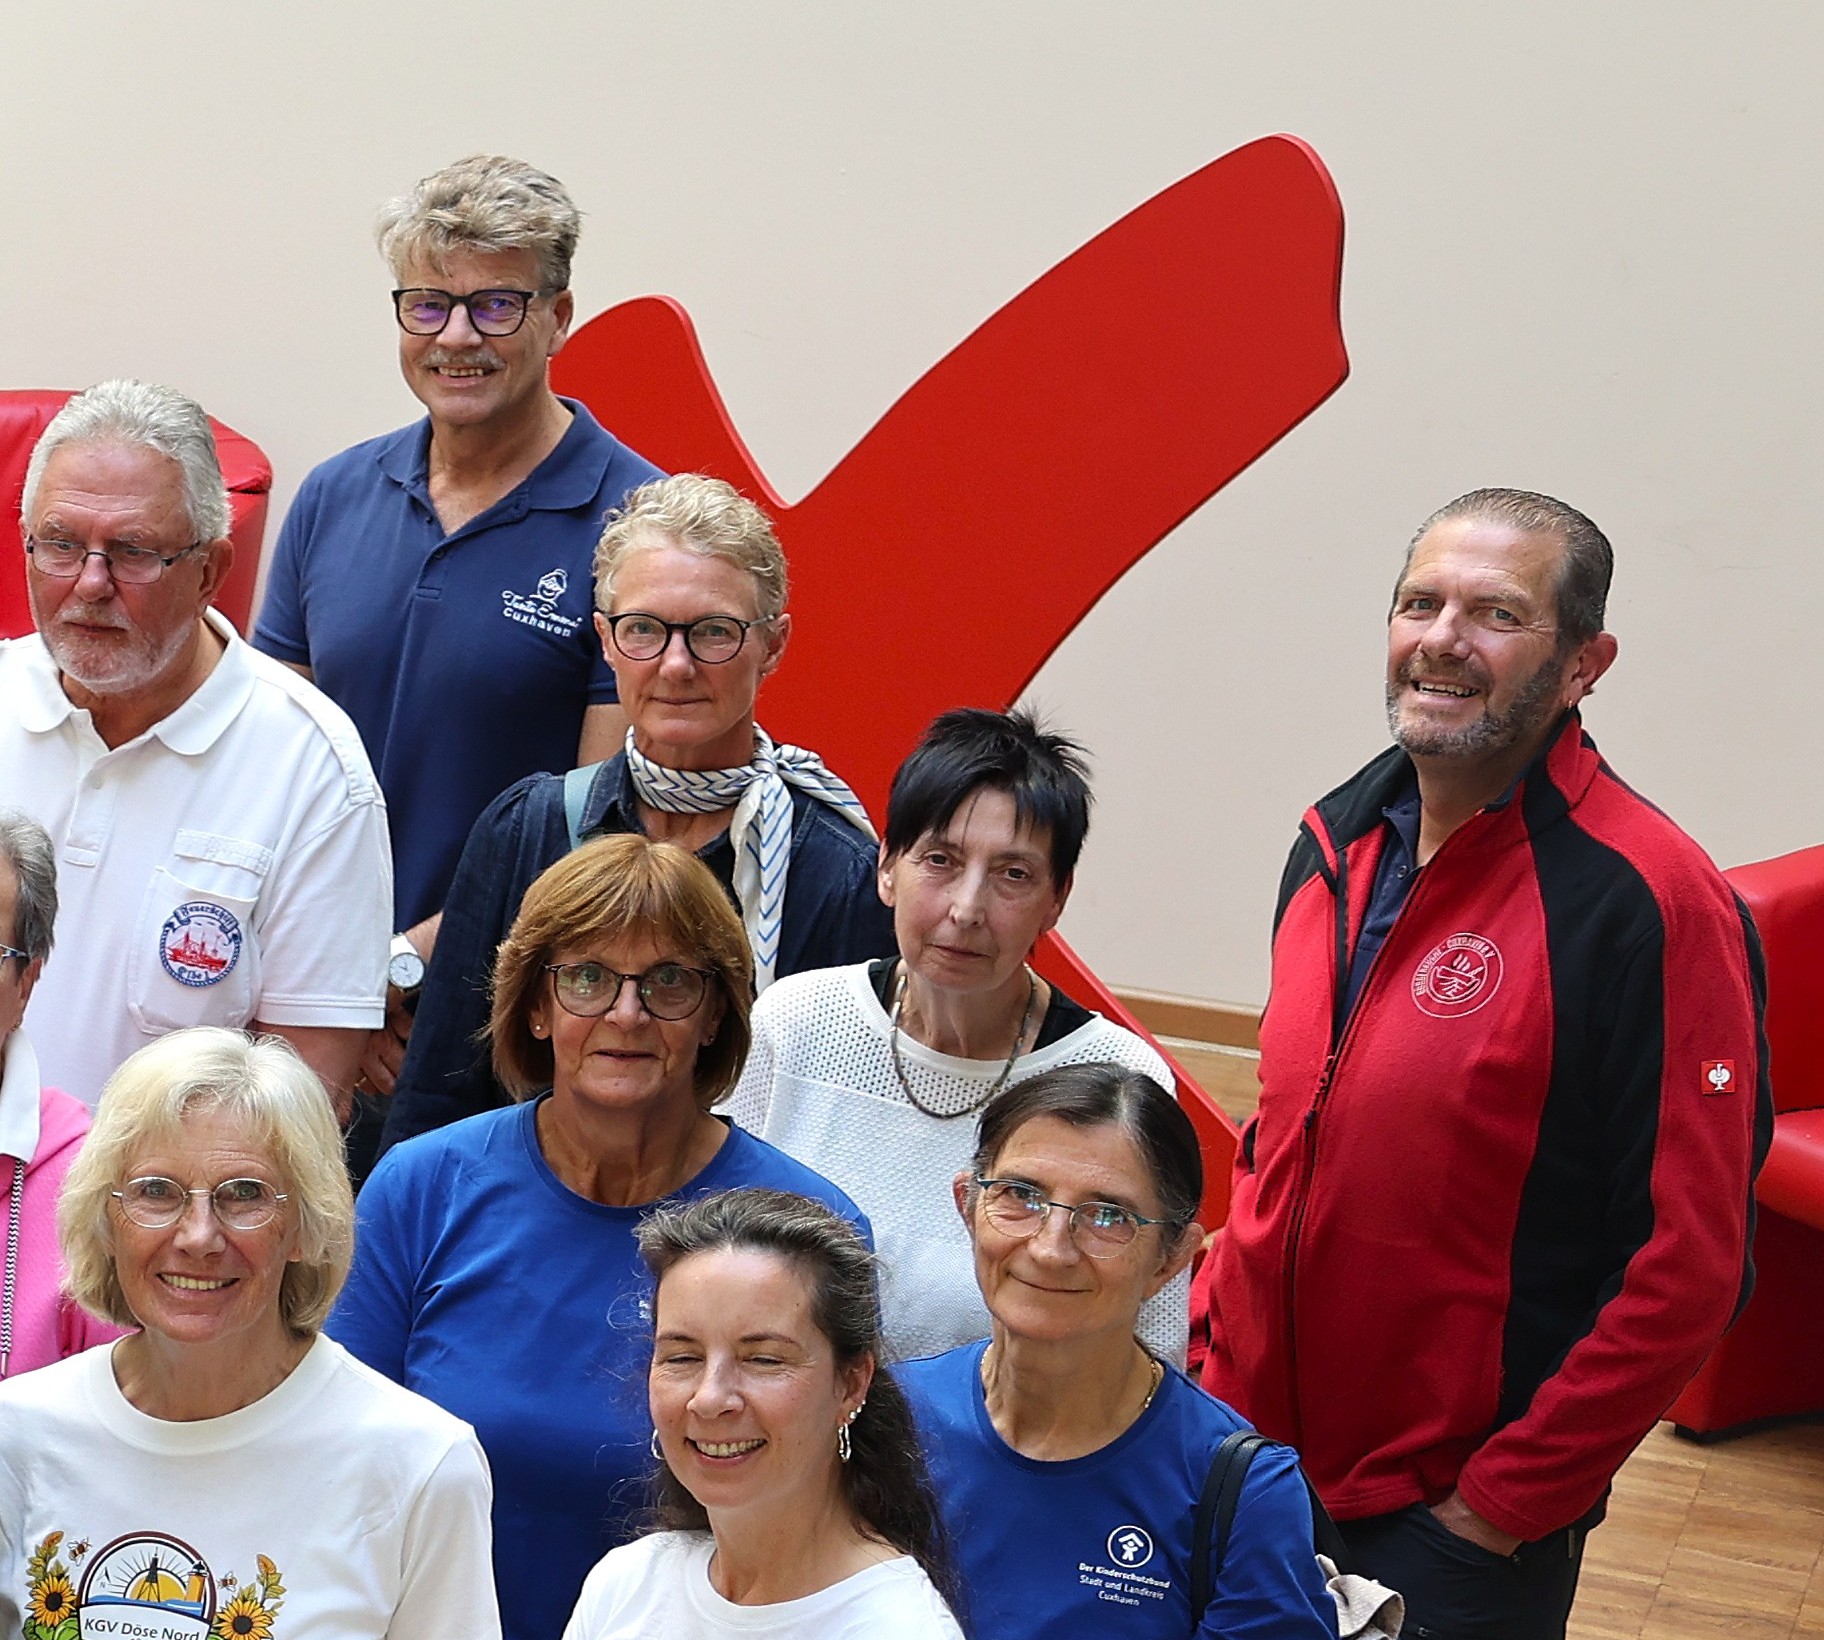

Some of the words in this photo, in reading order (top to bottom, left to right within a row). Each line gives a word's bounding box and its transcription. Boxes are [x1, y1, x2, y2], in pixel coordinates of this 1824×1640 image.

[502, 606, 572, 638] Cuxhaven
[1078, 1562, 1095, 1573] Der
[1095, 1565, 1171, 1589] Kinderschutzbund
[1079, 1574, 1103, 1587] Stadt
[1123, 1583, 1164, 1600] Landkreis
[1098, 1590, 1140, 1606] Cuxhaven
[84, 1618, 118, 1634] KGV
[121, 1622, 158, 1639] Döse
